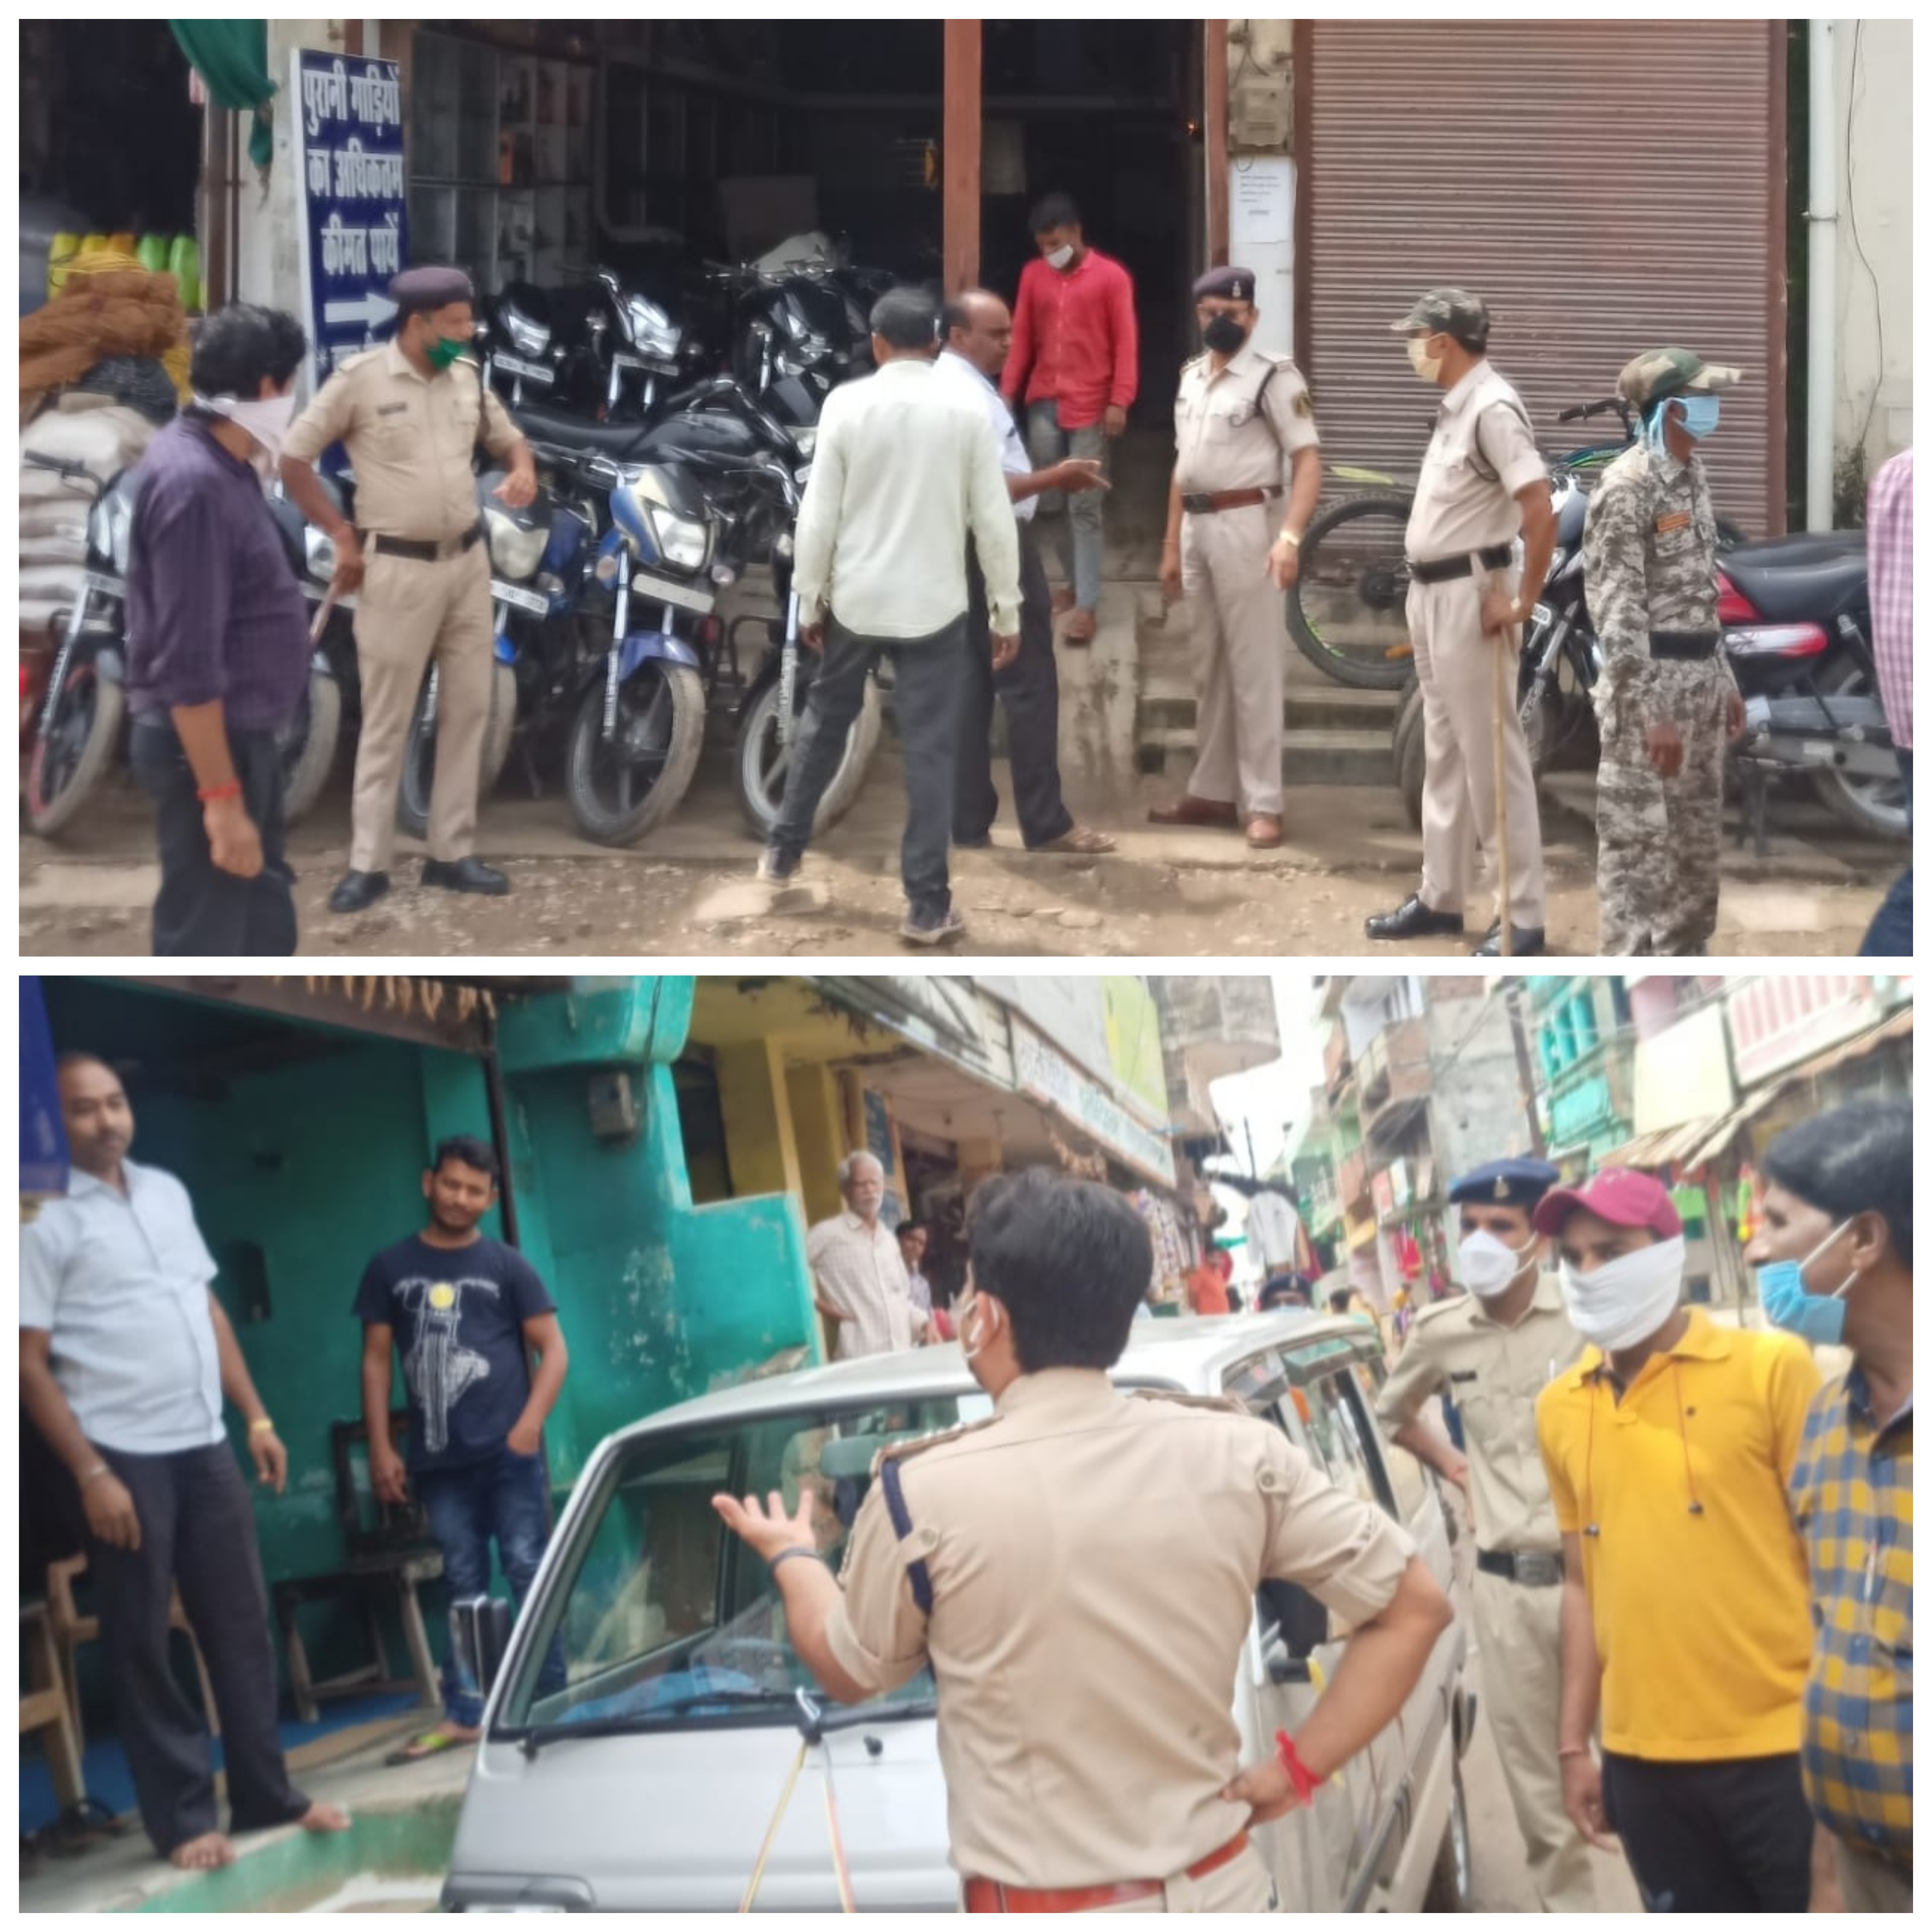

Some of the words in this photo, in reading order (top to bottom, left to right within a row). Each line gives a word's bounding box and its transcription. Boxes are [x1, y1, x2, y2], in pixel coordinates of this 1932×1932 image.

[303, 59, 347, 136] पुरानी
[350, 64, 400, 136] गाड़ियों
[307, 148, 330, 196] का
[335, 138, 403, 198] अधिकतम
[321, 213, 368, 275] कीमत
